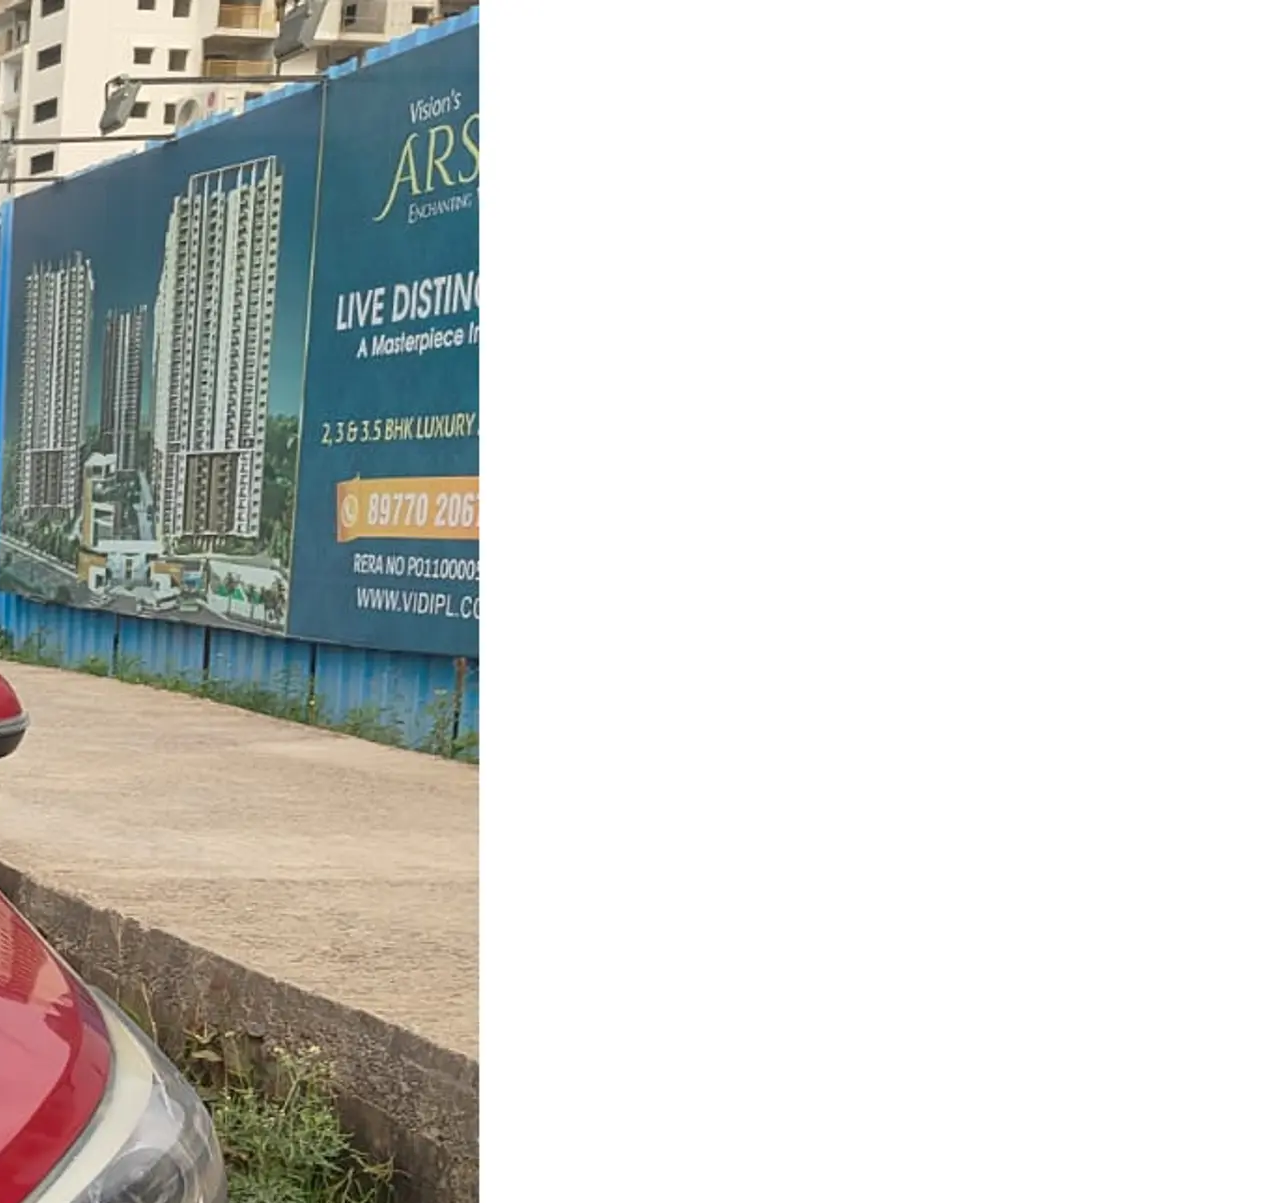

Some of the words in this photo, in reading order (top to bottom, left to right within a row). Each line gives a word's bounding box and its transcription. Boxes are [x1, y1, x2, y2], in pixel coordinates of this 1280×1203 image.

[409, 89, 461, 124] Vision's
[336, 287, 386, 330] LIVE
[356, 337, 369, 358] A
[371, 327, 464, 356] Masterpiece
[384, 416, 415, 440] BHK
[416, 412, 476, 438] LUXURY
[368, 492, 428, 526] 89770
[353, 553, 383, 575] RERA
[385, 555, 405, 576] NO
